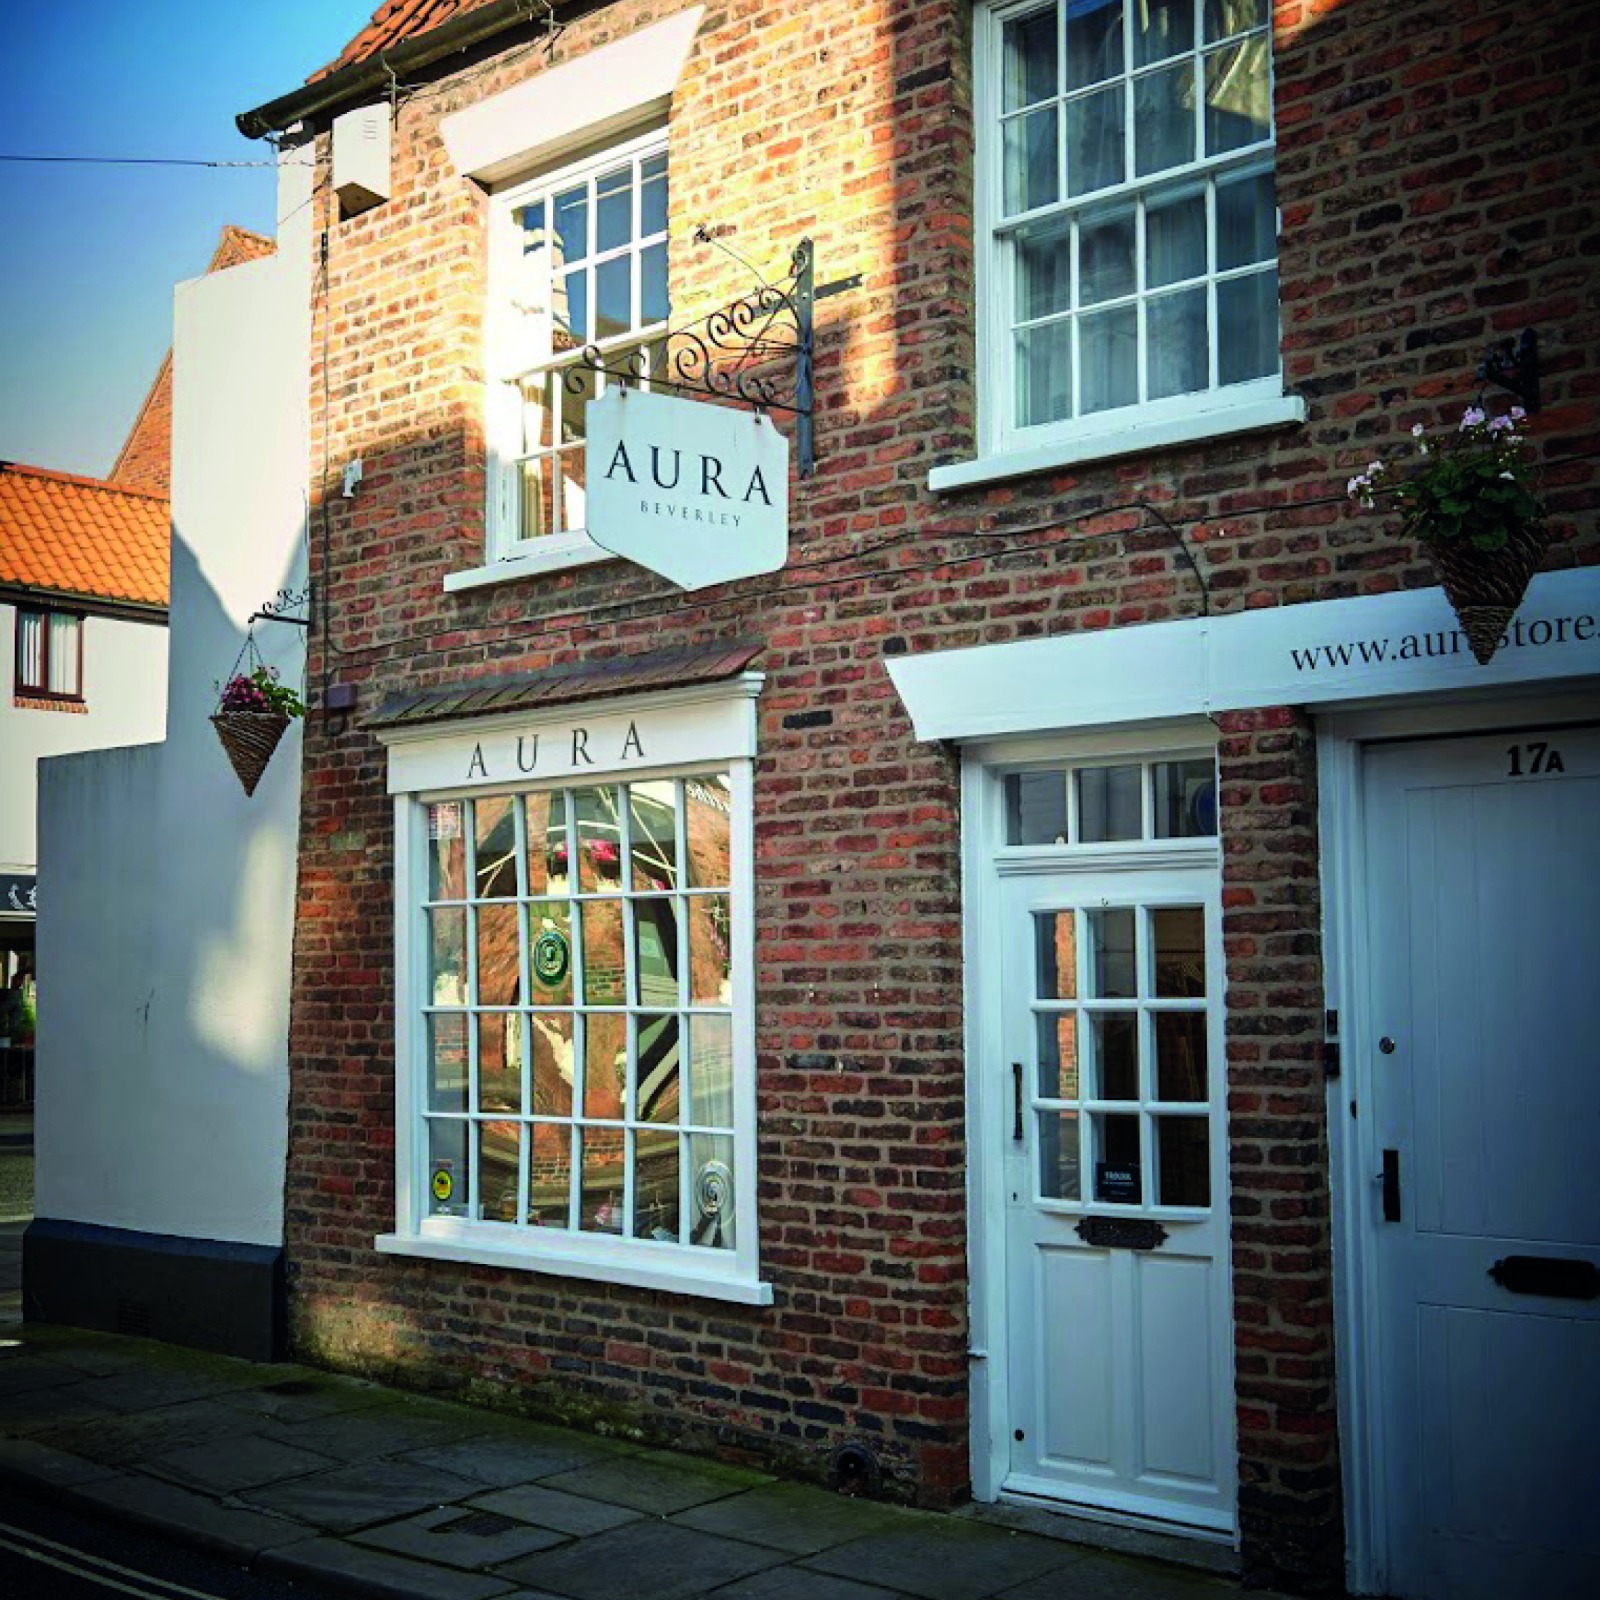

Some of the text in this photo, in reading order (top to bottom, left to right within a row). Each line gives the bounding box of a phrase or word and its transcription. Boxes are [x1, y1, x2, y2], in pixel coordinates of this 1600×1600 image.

[603, 439, 774, 506] AURA
[640, 500, 742, 527] BEVERLEY
[466, 719, 646, 778] AURA
[1507, 743, 1565, 776] 17A
